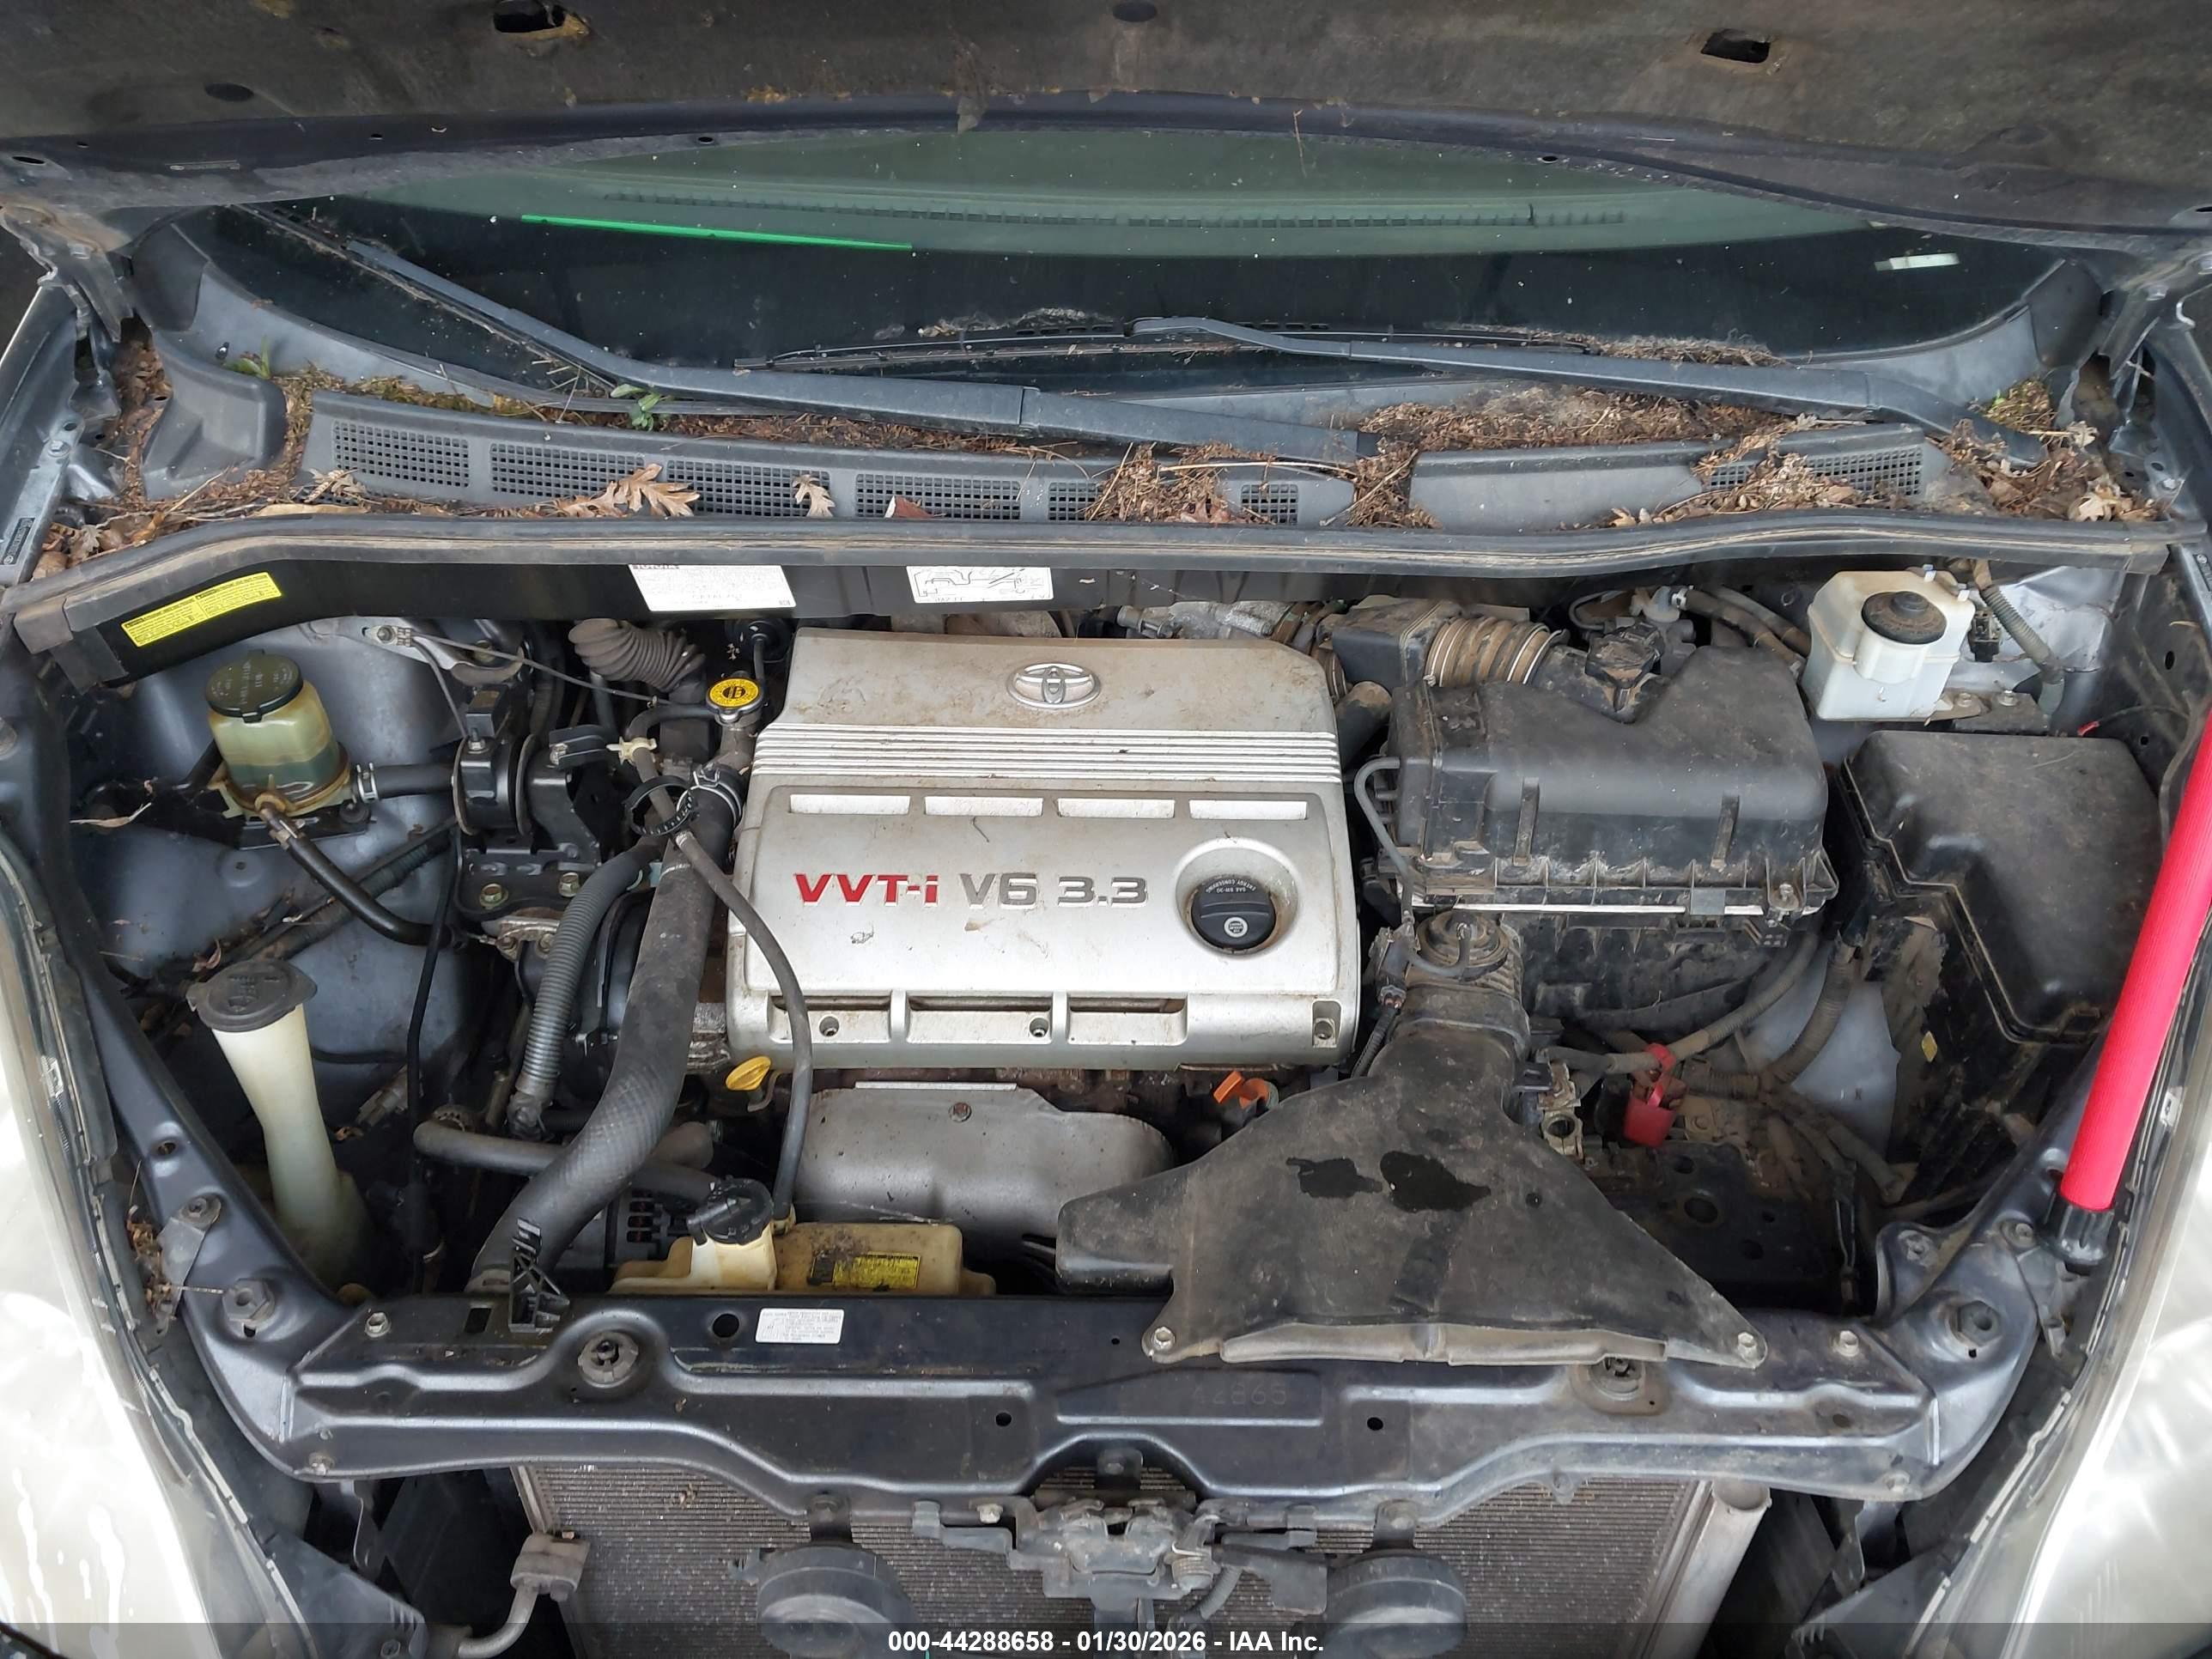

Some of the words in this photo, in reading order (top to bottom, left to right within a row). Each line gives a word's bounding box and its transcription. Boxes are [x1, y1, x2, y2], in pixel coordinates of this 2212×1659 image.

[793, 872, 941, 907] VVT-i
[959, 872, 1039, 910] V6
[1056, 875, 1149, 908] 3.3
